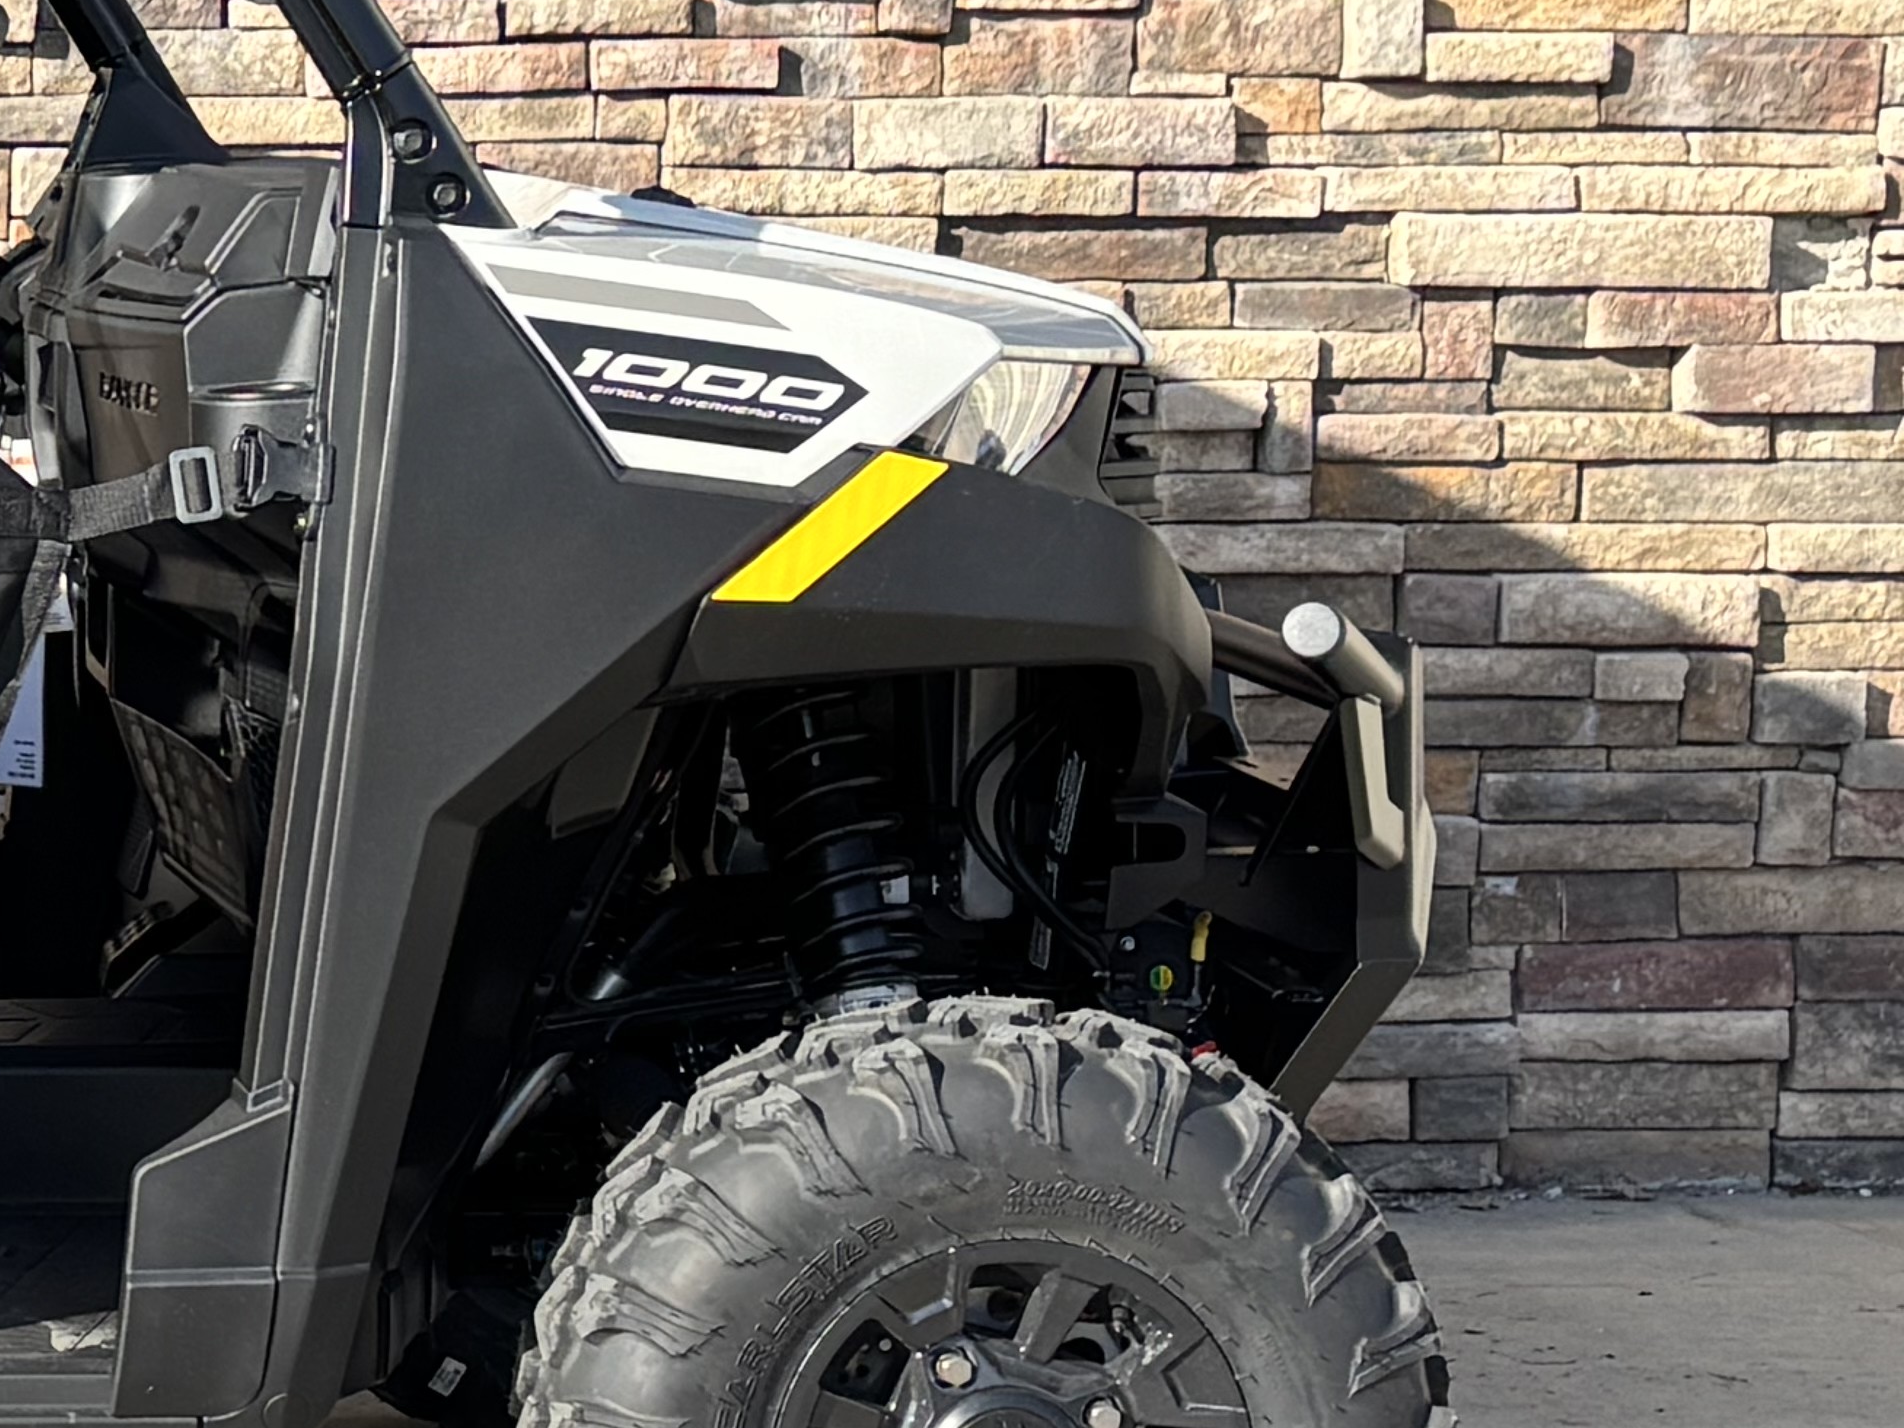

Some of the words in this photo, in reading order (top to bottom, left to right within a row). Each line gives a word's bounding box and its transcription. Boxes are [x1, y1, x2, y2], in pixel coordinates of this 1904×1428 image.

[573, 347, 845, 411] 1000
[588, 384, 665, 404] SINGLE
[669, 395, 777, 420] OVERHEAD
[778, 412, 823, 427] CAM
